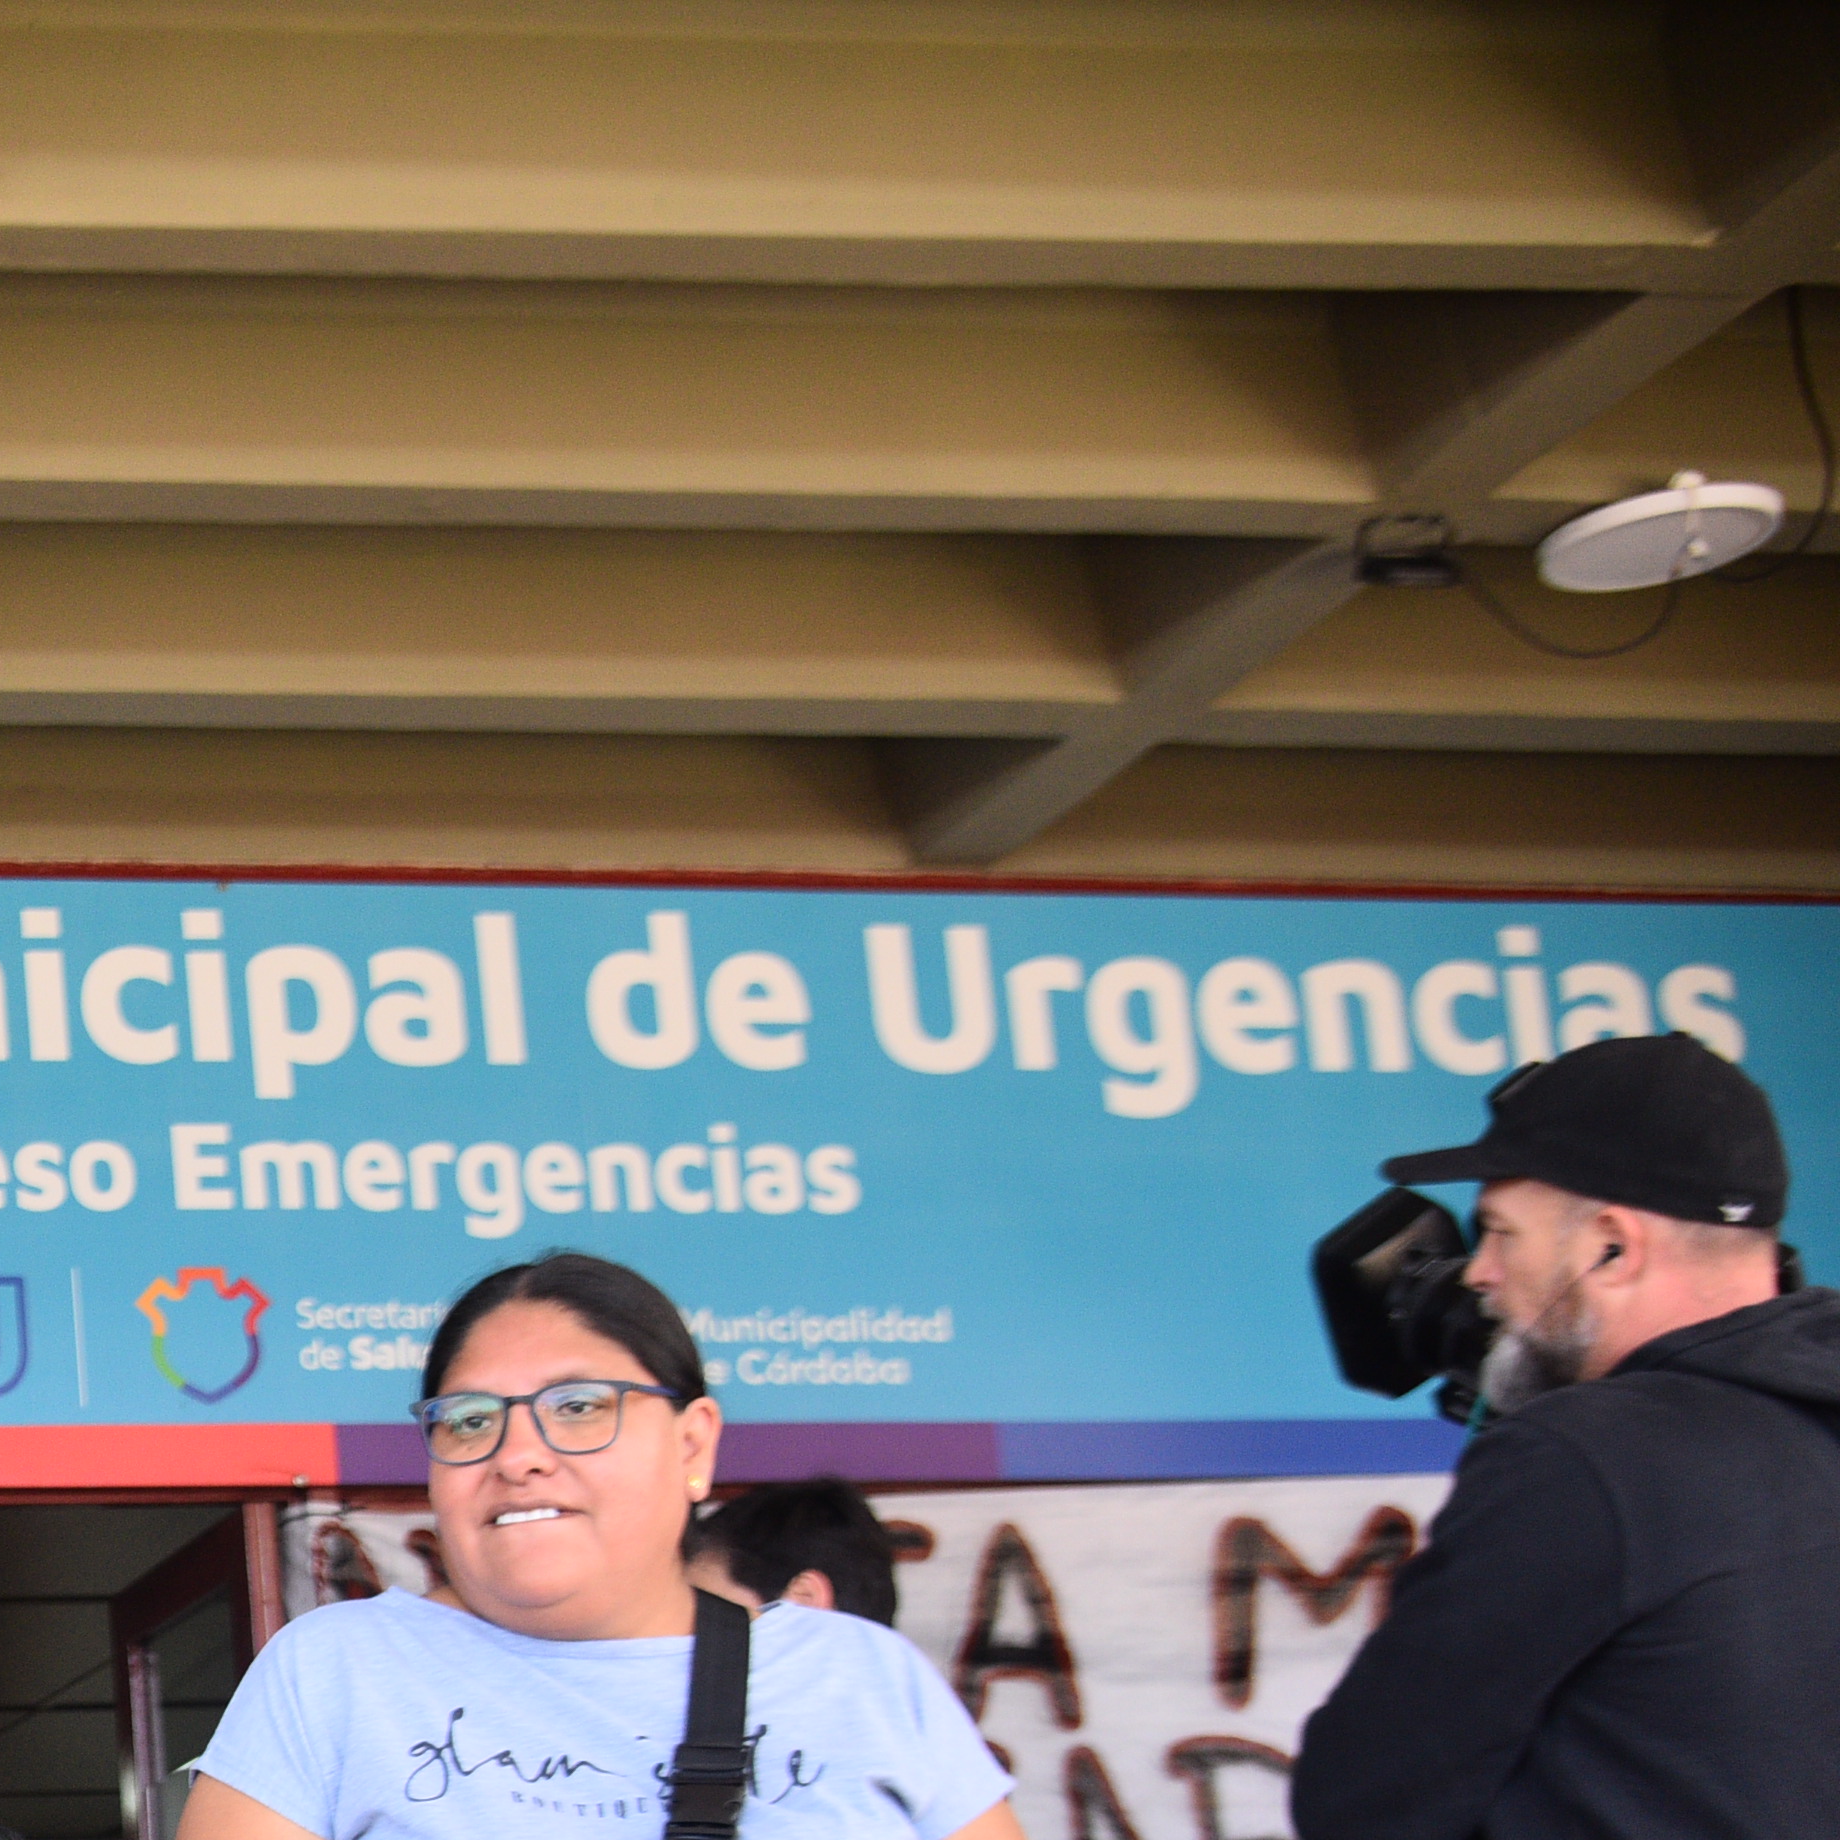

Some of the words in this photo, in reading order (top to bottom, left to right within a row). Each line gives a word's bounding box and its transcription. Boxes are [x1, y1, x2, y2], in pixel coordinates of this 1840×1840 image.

[584, 909, 813, 1073] de
[863, 922, 1744, 1119] Urgencias
[169, 1122, 863, 1240] Emergencias
[299, 1339, 345, 1371] de
[735, 1350, 912, 1386] Córdoba
